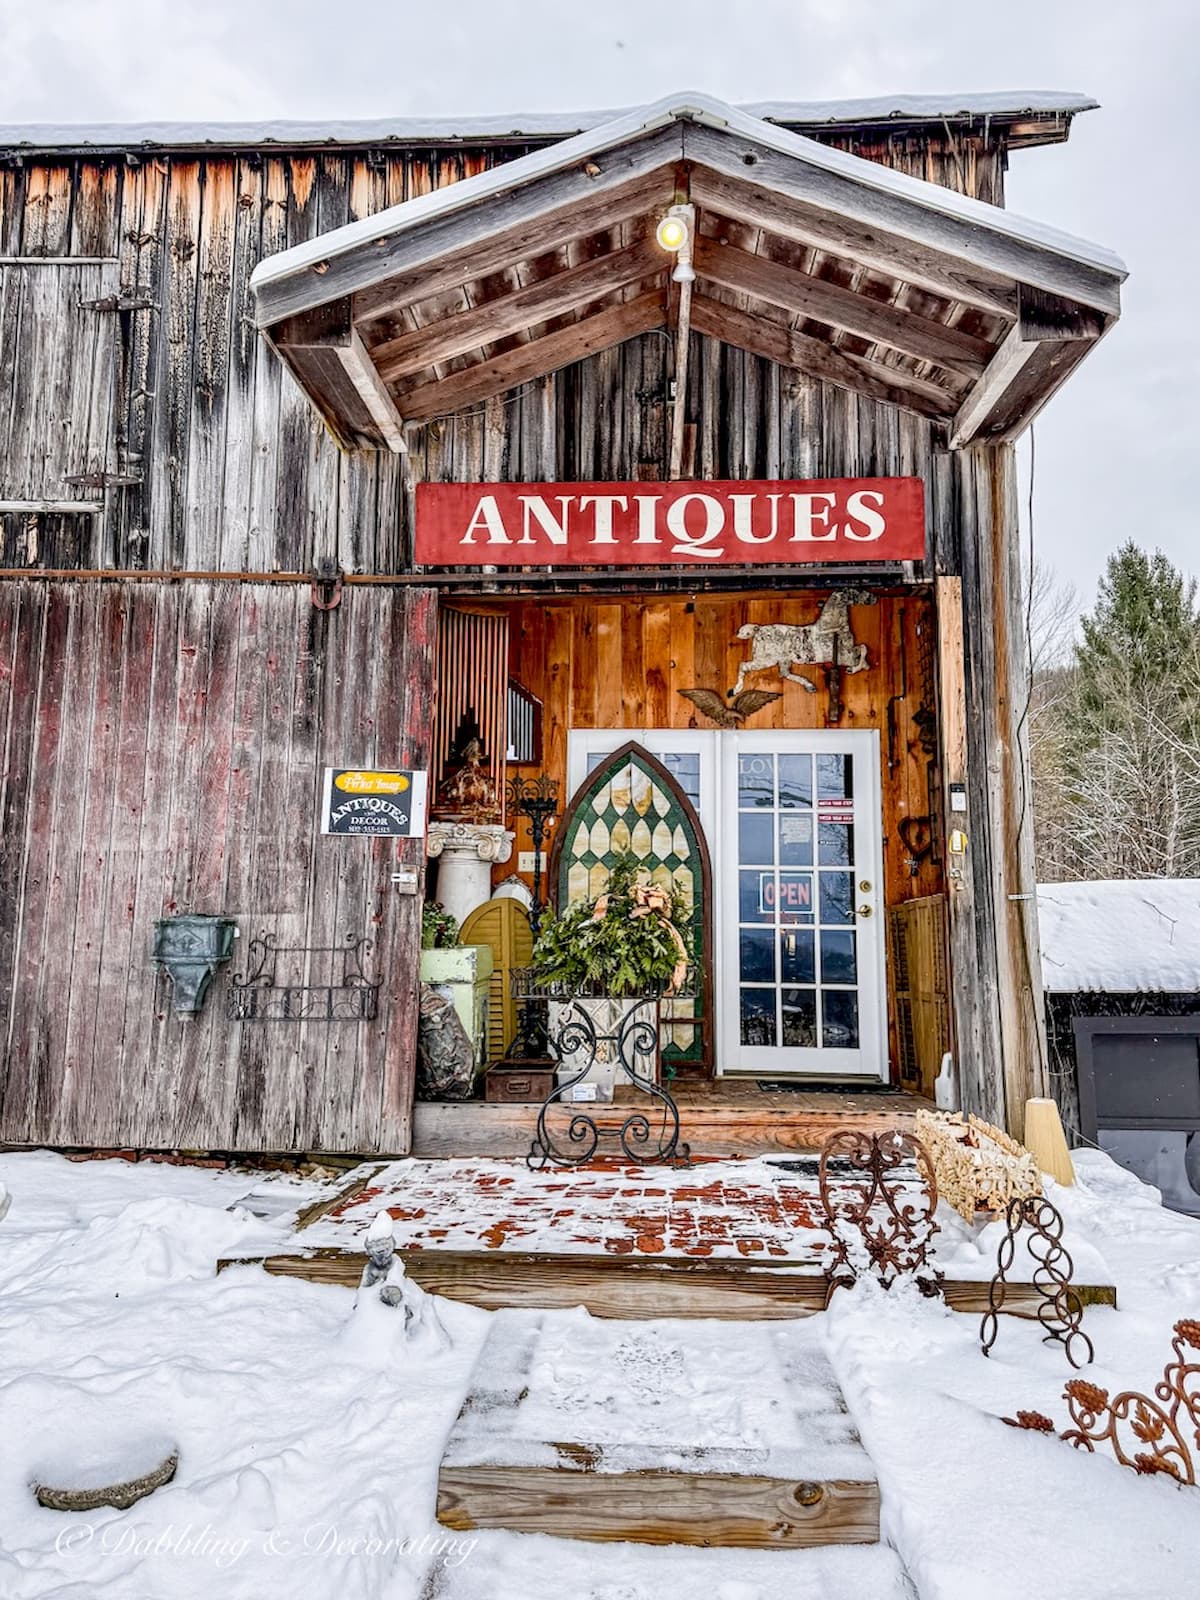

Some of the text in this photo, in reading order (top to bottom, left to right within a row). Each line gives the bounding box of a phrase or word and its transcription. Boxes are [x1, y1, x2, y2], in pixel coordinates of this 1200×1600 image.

[459, 490, 885, 557] ANTIQUES
[331, 797, 408, 826] ANTIQUES
[351, 816, 388, 825] DECOR
[765, 882, 809, 905] OPEN
